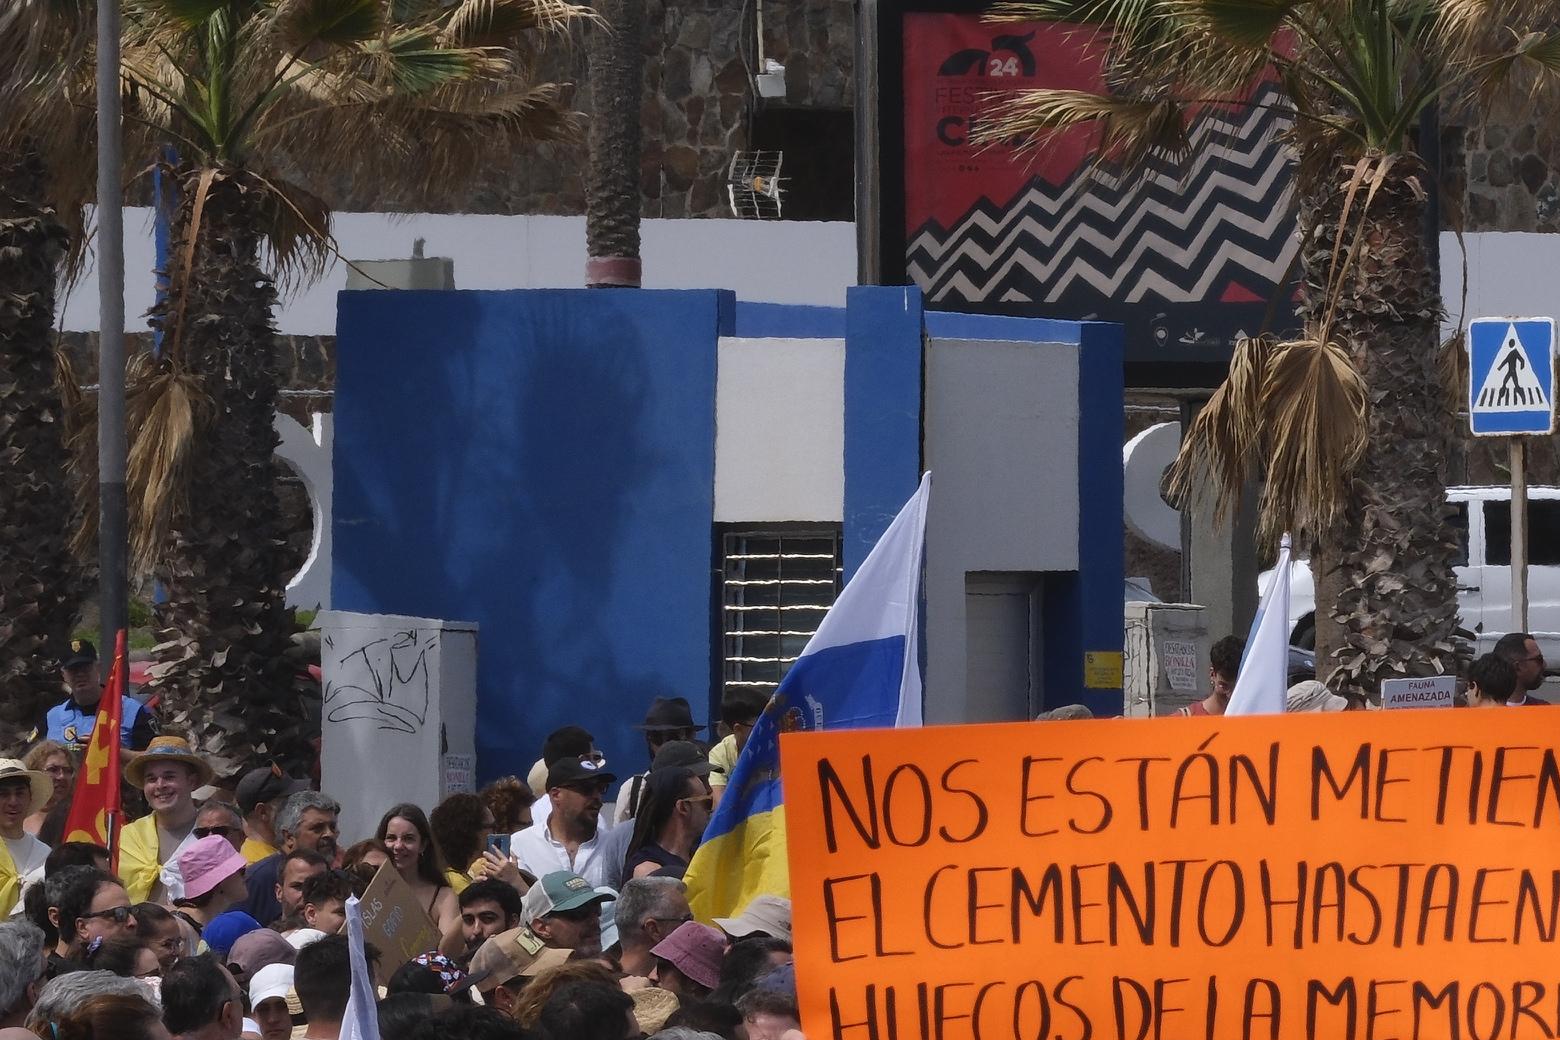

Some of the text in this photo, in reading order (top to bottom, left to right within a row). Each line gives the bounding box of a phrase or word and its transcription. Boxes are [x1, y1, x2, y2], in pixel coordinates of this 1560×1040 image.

[990, 57, 1018, 77] 24
[1408, 680, 1436, 691] FAUNA
[1390, 690, 1451, 703] AMENAZADA
[817, 753, 989, 855] NOS
[1019, 733, 1279, 839] ESTÁN
[822, 871, 914, 964] EL
[923, 858, 1246, 950] CEMENTO
[1260, 858, 1460, 950] HASTA
